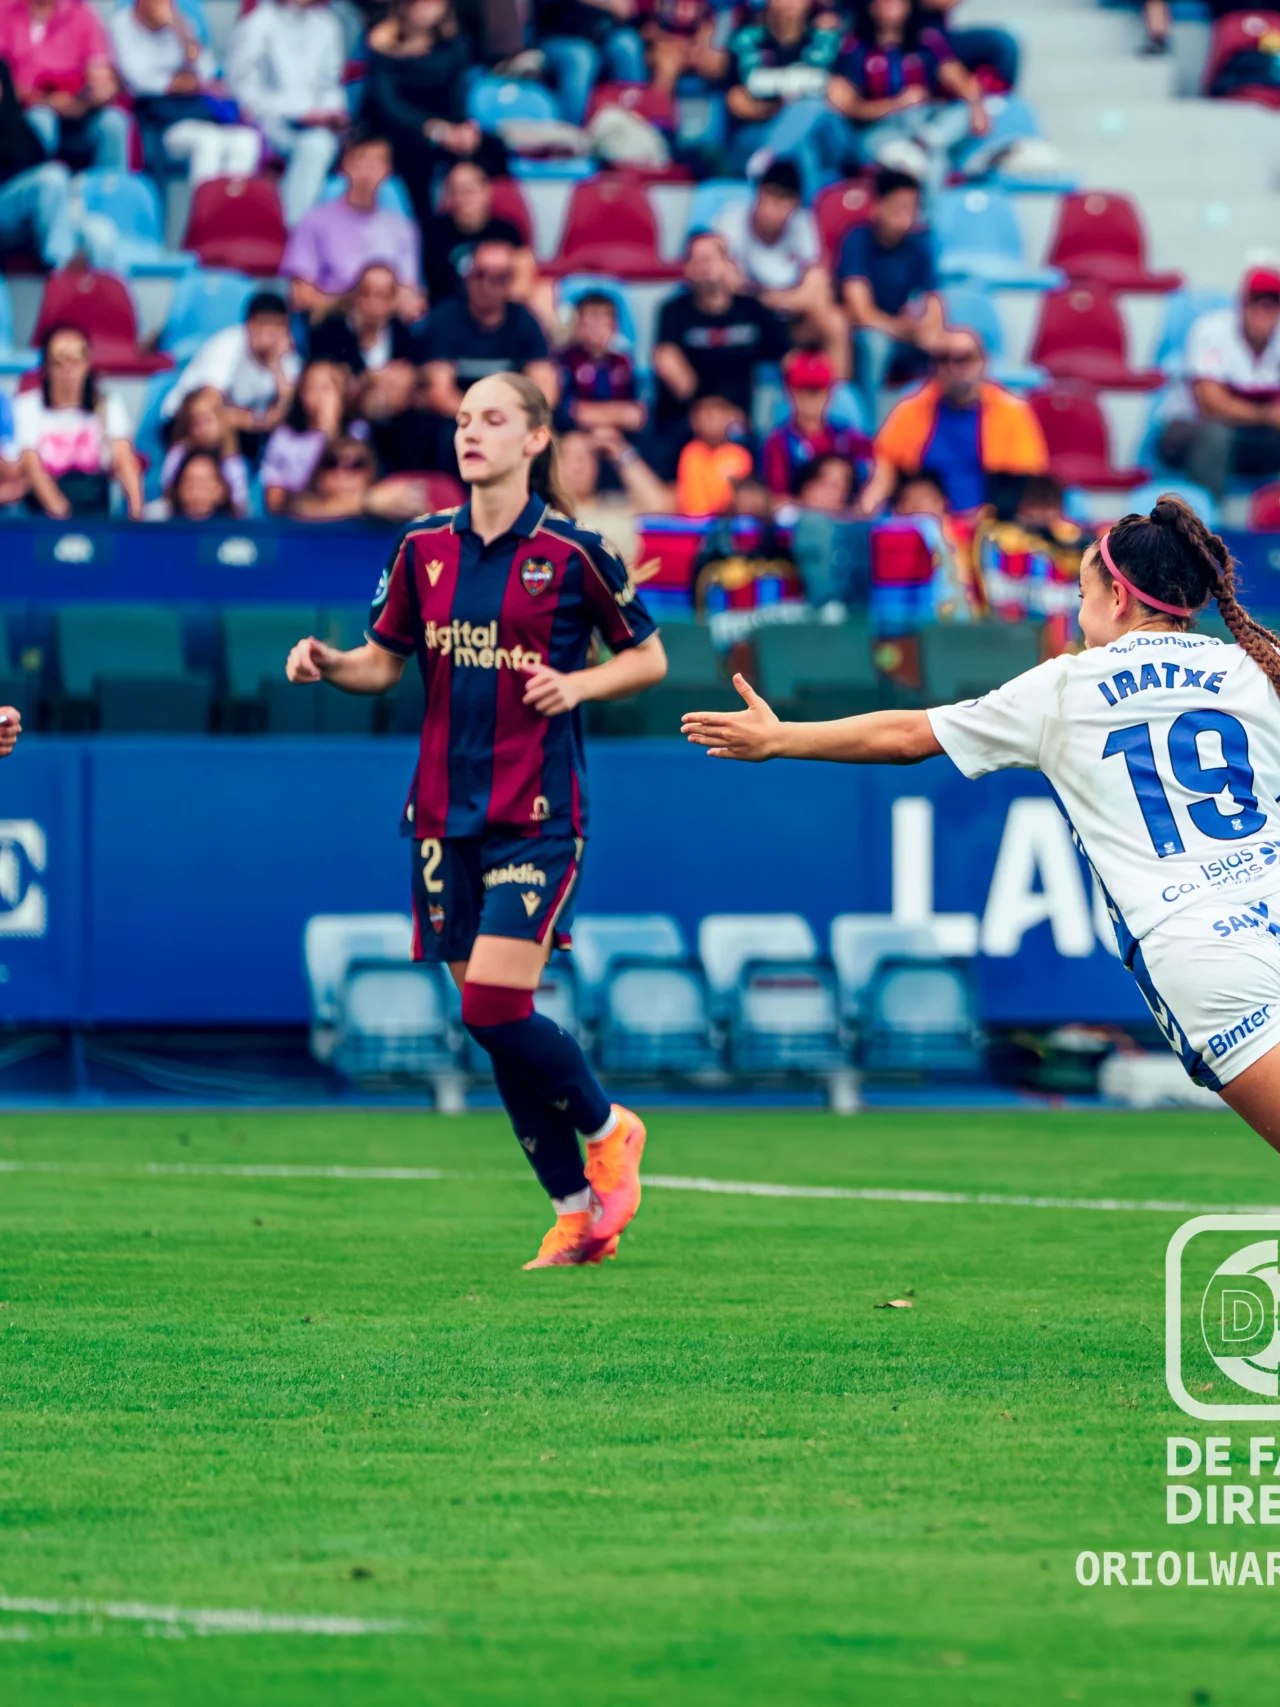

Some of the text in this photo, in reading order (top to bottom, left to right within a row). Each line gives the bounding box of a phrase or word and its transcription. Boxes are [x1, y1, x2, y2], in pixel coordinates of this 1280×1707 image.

[425, 618, 498, 656] digital
[454, 643, 542, 672] menta
[1097, 662, 1228, 707] IRATXE
[1101, 708, 1268, 859] 19
[420, 837, 445, 893] 2
[1200, 848, 1254, 881] Islas
[1207, 1004, 1271, 1059] Binter
